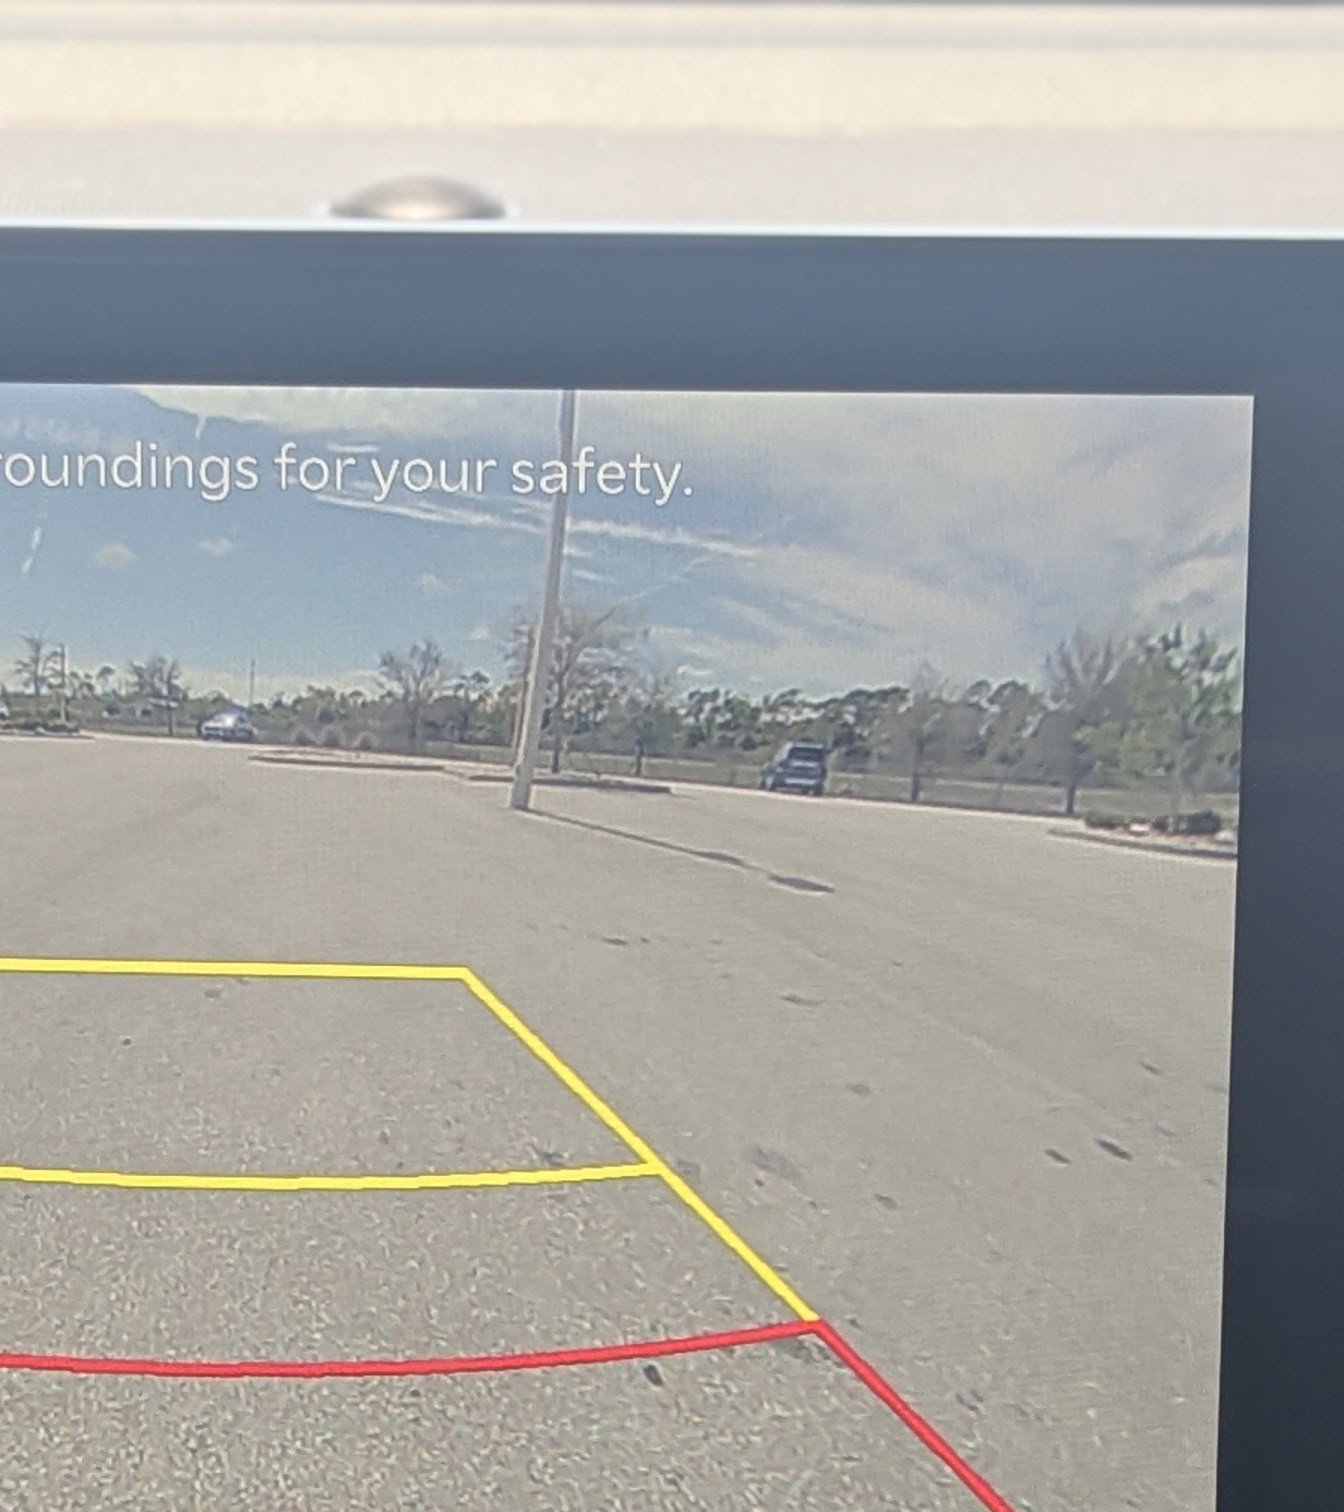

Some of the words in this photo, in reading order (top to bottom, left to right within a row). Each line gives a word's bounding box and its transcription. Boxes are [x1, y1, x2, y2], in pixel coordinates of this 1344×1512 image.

[273, 442, 358, 495] for
[371, 457, 497, 505] your
[511, 446, 695, 505] safety.
